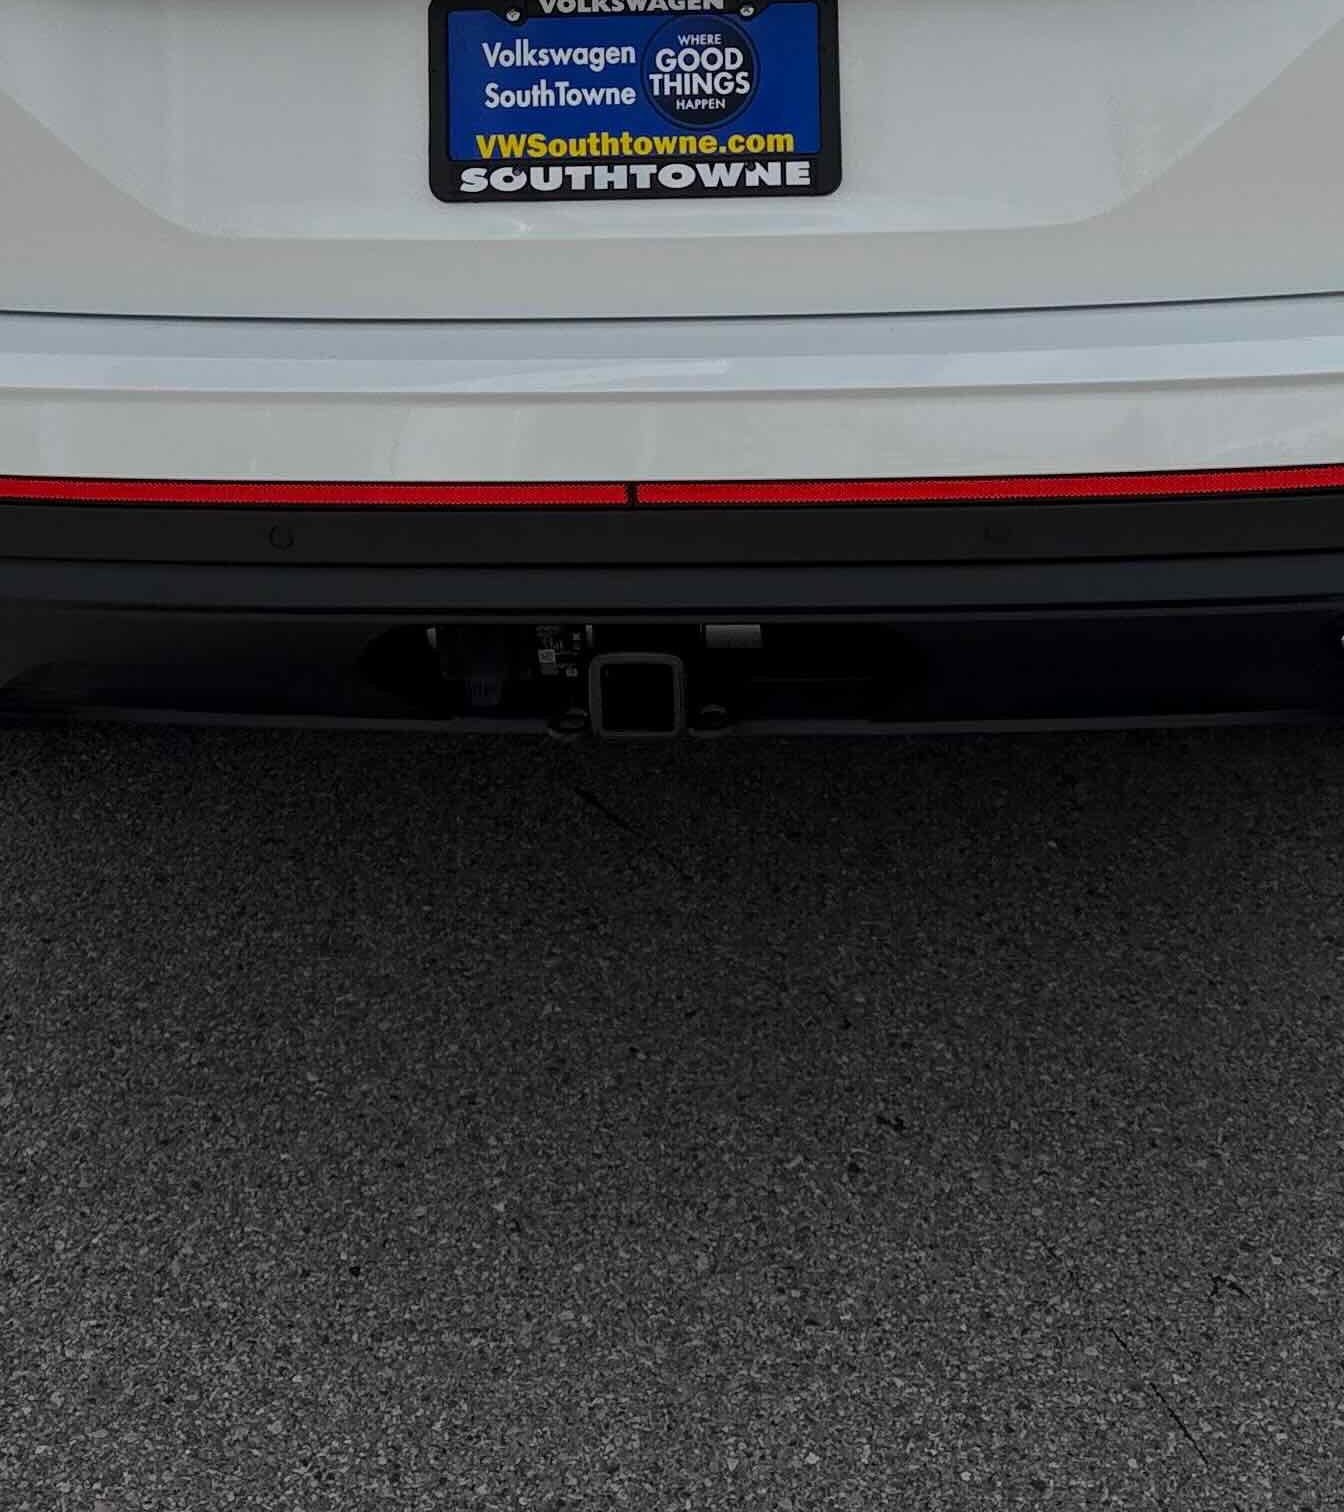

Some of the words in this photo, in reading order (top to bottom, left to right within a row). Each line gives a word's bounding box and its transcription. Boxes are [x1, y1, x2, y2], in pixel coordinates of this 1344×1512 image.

[678, 33, 721, 46] WHERE
[482, 38, 636, 73] Volkswagen
[655, 47, 744, 73] GOOD
[649, 71, 751, 96] THINGS
[676, 97, 726, 111] HAPPEN
[476, 131, 795, 159] VWSouthtowne.com
[460, 161, 811, 193] SOUTHTOWNE
